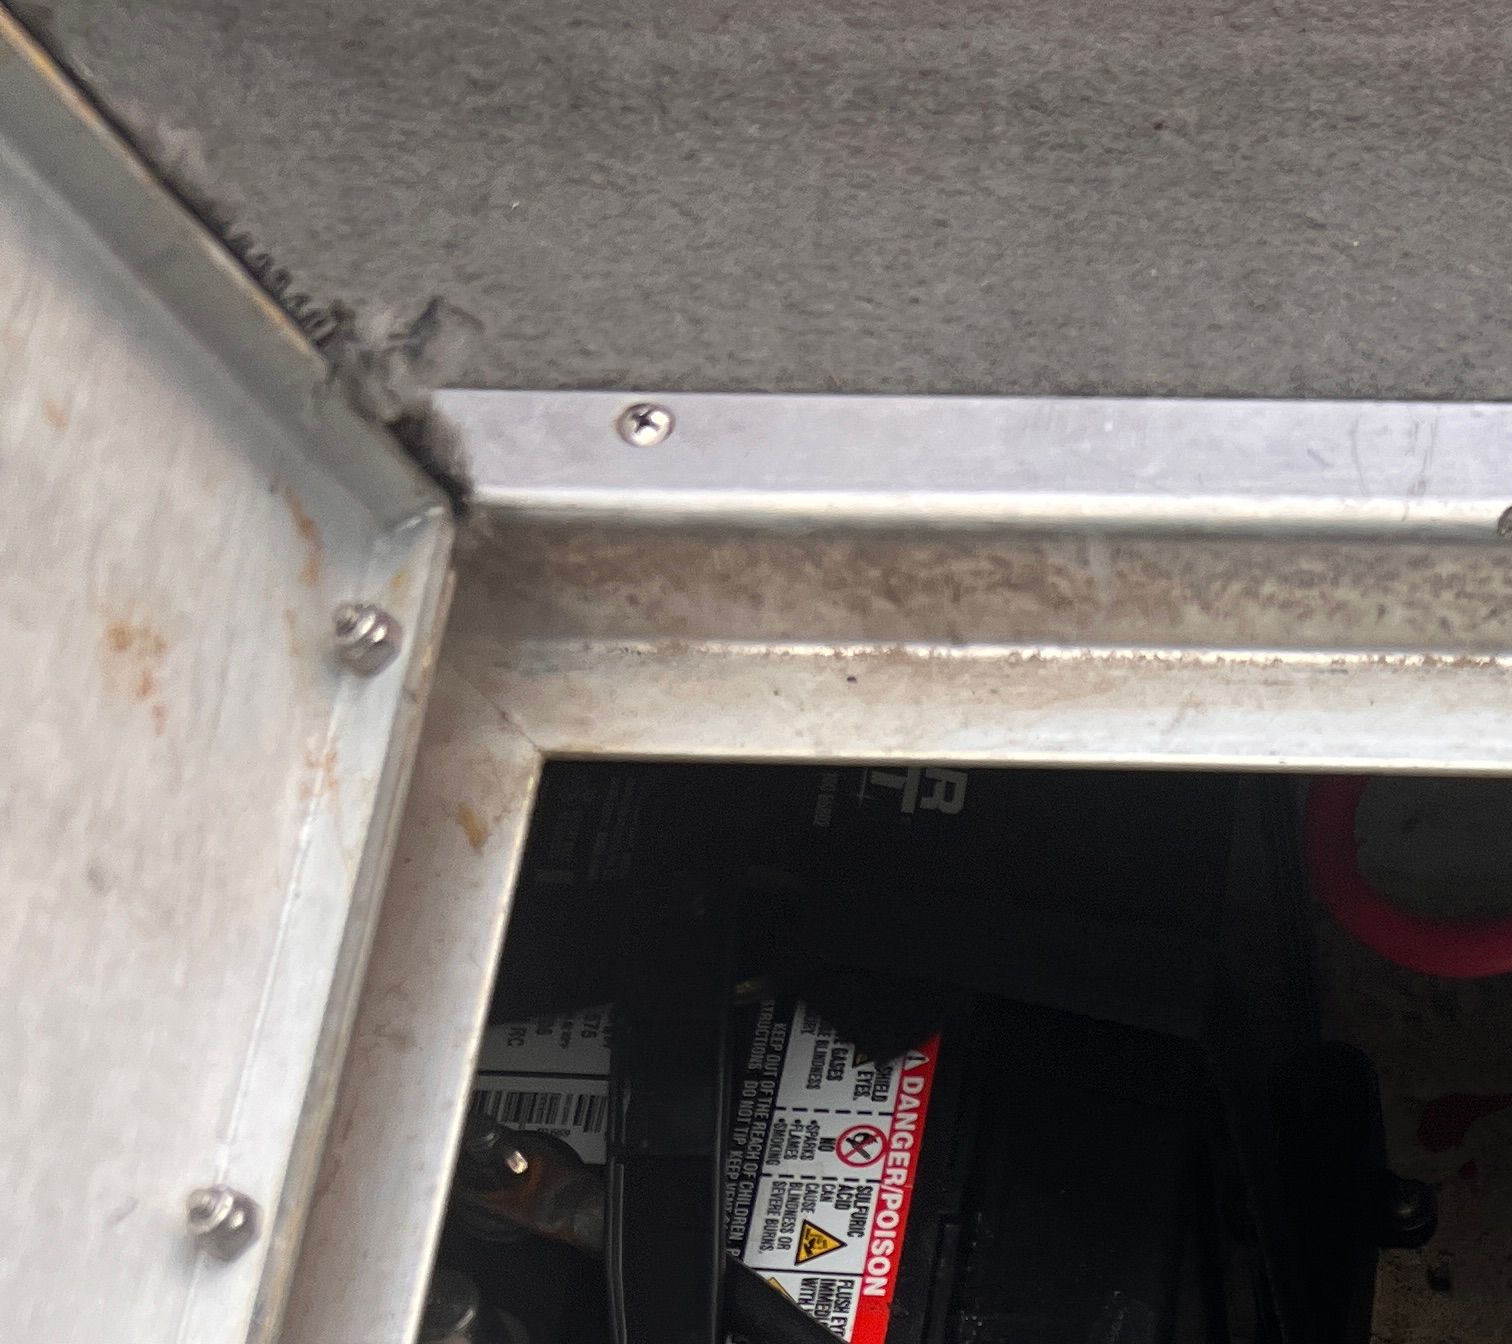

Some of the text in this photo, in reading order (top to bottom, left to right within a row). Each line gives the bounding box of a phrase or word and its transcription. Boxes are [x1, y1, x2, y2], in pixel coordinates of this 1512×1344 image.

[769, 1023, 787, 1052] KEEP
[763, 1054, 781, 1077] OUT
[742, 1080, 759, 1097] DO
[760, 1080, 776, 1097] OF
[736, 1099, 755, 1123] NOT
[754, 1097, 773, 1119] THE
[745, 1122, 768, 1160] REACH
[818, 1137, 836, 1152] NO
[741, 1162, 760, 1180] OF
[767, 1181, 788, 1217] SEVERE
[801, 1183, 820, 1214] CAUSE
[819, 1184, 836, 1203] CAN
[834, 1184, 857, 1211] ACID
[863, 1077, 925, 1297] DANGER/POISON
[776, 1182, 803, 1251] BLINDNESS OR
[847, 1185, 874, 1239] SULFURIC
[797, 1278, 819, 1305] WITH
[833, 1279, 856, 1314] FLUSH
